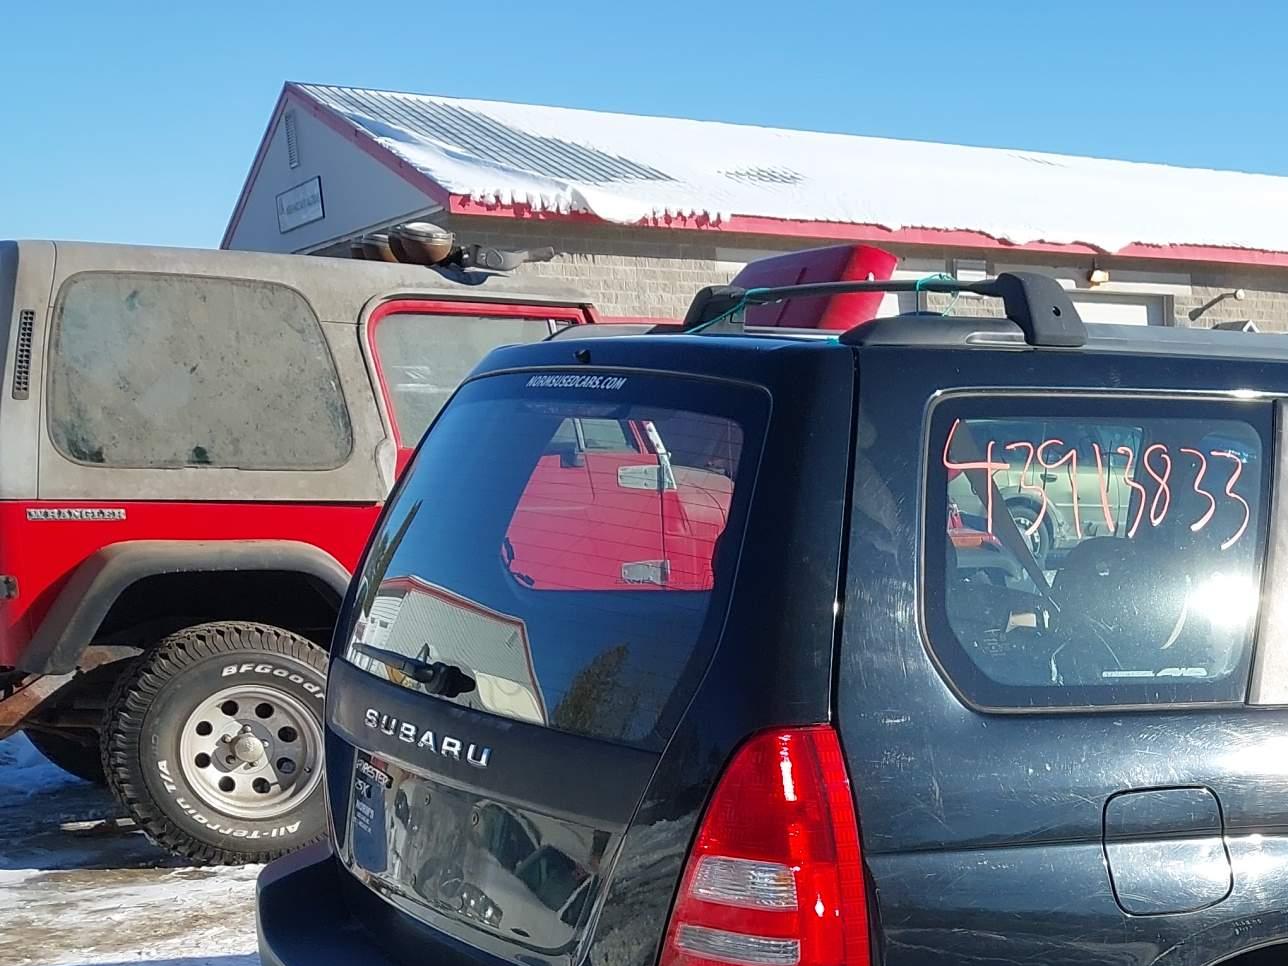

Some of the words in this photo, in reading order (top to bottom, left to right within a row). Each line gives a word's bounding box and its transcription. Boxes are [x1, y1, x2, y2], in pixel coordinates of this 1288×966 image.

[526, 375, 628, 390] NORMSUSEDCARS.COM
[942, 417, 1250, 550] 43913833
[26, 508, 127, 520] WRANGLER
[364, 708, 492, 768] SUBARU
[157, 760, 177, 793] T/A
[176, 798, 302, 840] All-Terrain
